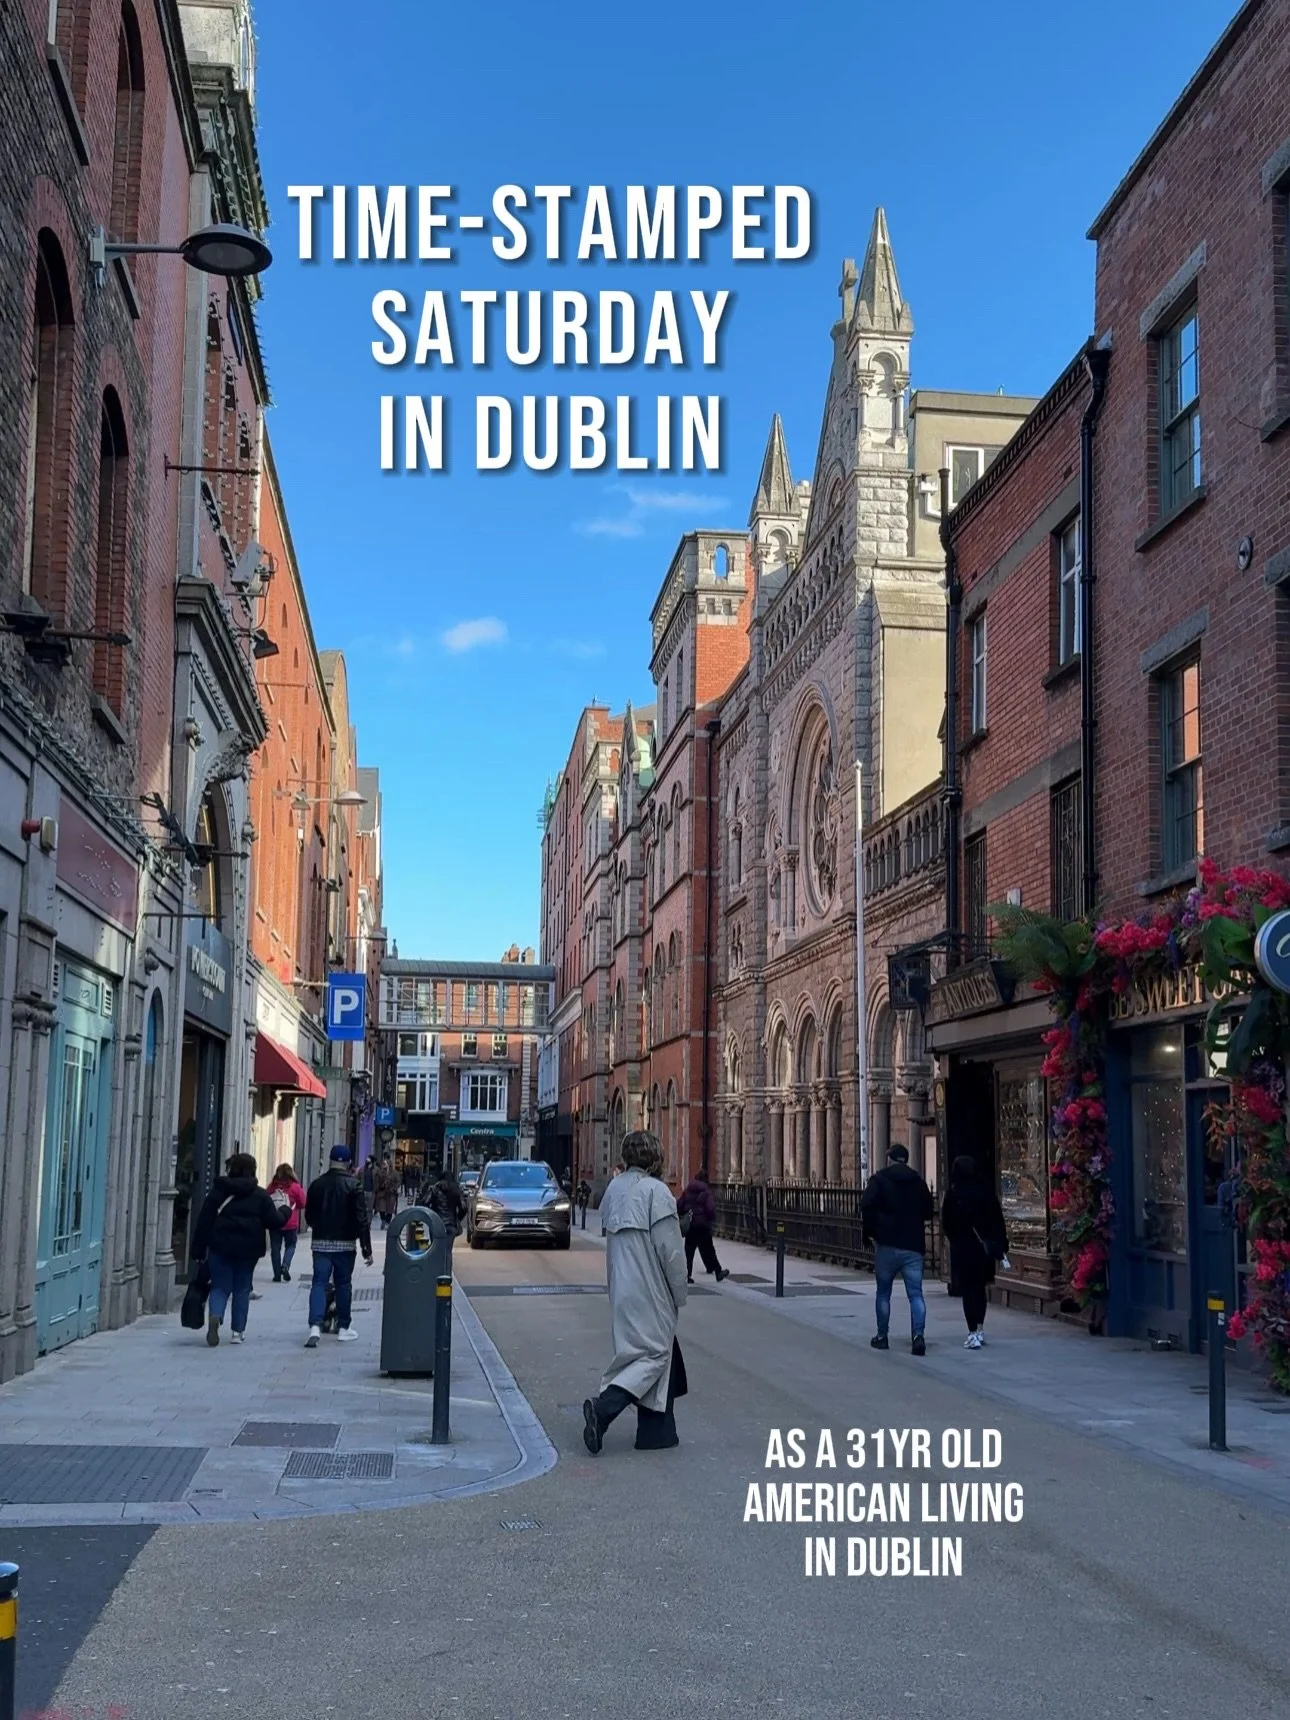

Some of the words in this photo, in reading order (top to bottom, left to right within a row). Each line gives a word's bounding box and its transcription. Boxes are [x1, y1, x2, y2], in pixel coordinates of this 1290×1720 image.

[333, 989, 359, 1024] P
[942, 971, 998, 1016] ANTIQUES
[381, 1108, 390, 1120] P
